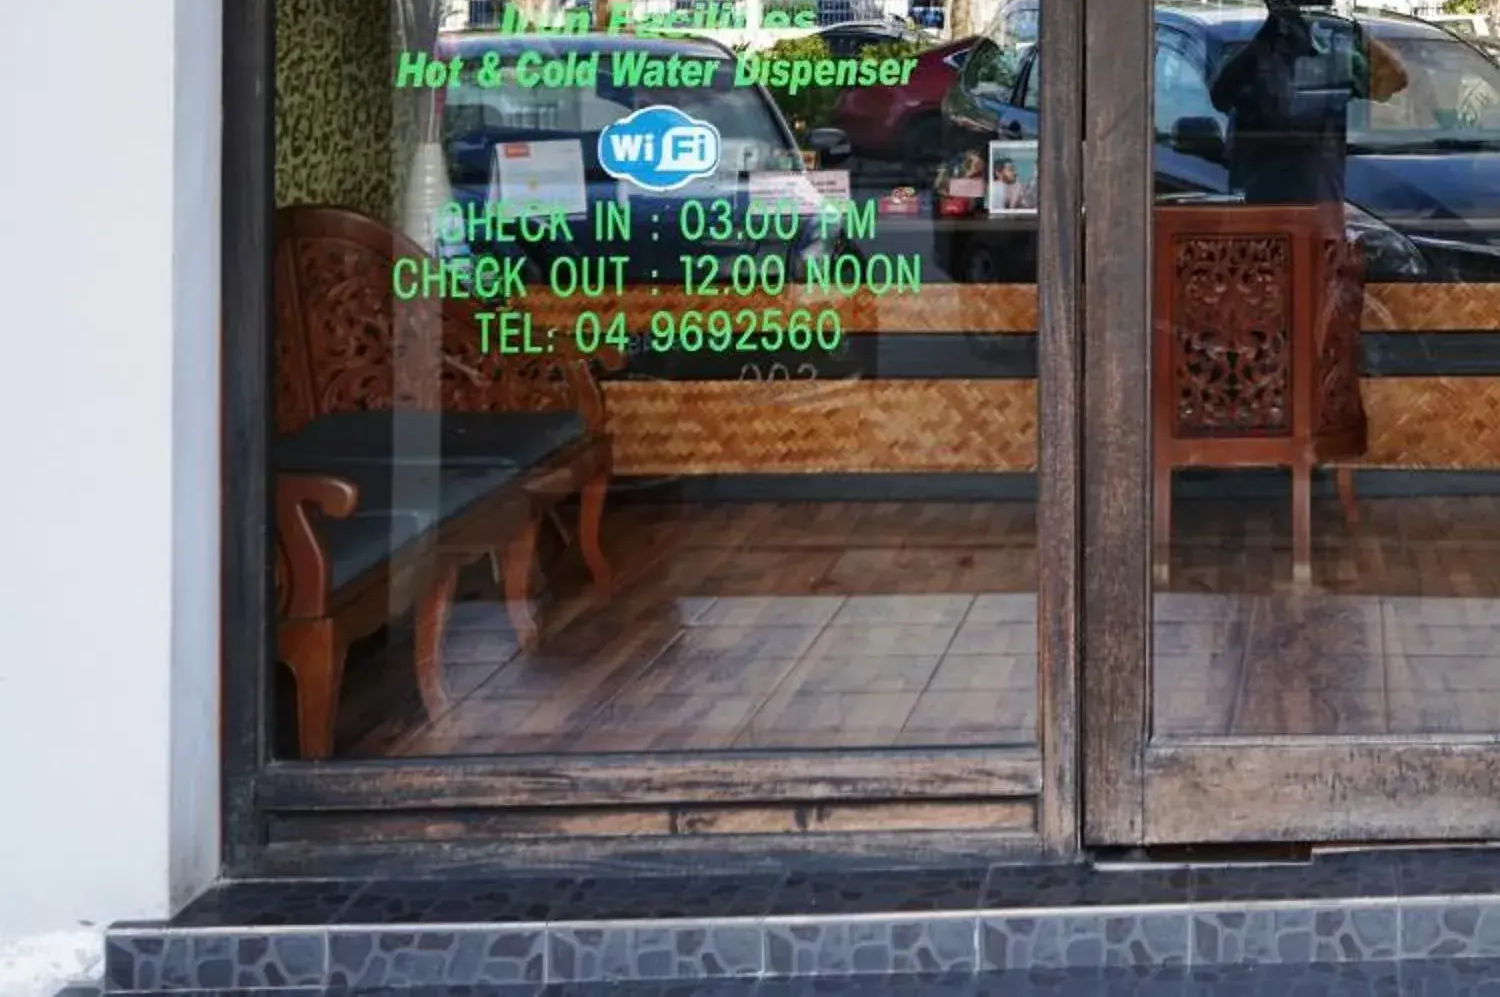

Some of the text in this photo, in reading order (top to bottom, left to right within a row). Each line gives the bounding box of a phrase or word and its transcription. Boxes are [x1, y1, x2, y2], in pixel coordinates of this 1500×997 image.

[501, 2, 591, 37] Irn
[396, 51, 918, 95] Hot & Cold Water Dispenser
[436, 202, 574, 242] CHECK
[594, 200, 632, 242] IN
[679, 199, 800, 242] 03.00
[819, 200, 878, 241] PM
[392, 257, 528, 300] CHECK
[550, 256, 631, 299] OUT
[680, 253, 787, 299] 12.00
[804, 253, 923, 296] NOON
[474, 309, 843, 355] TEL: 04 9692560
